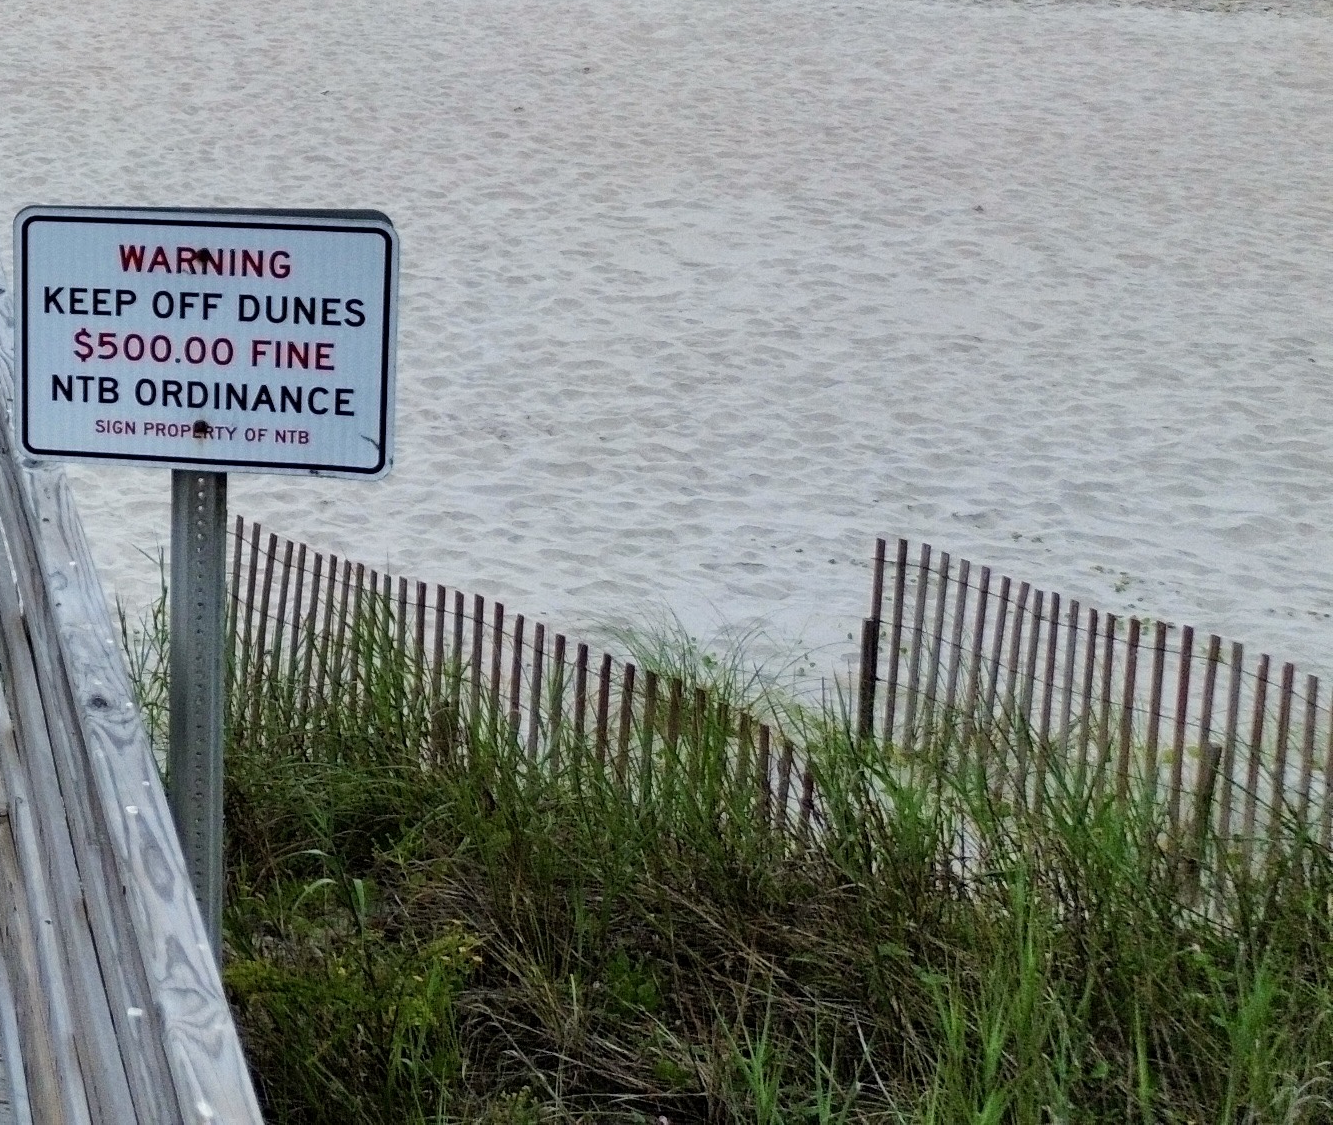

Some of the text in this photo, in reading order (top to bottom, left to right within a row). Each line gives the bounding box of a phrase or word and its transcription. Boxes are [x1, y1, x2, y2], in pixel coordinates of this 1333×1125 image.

[119, 244, 290, 278] WARNING
[44, 286, 366, 326] KEEP OFF DUNES
[73, 328, 335, 371] $500.00 FINE
[51, 374, 355, 416] NTB ORDINANCE
[95, 419, 136, 434] SIGN
[244, 428, 268, 442] OF
[275, 430, 309, 444] NTB
